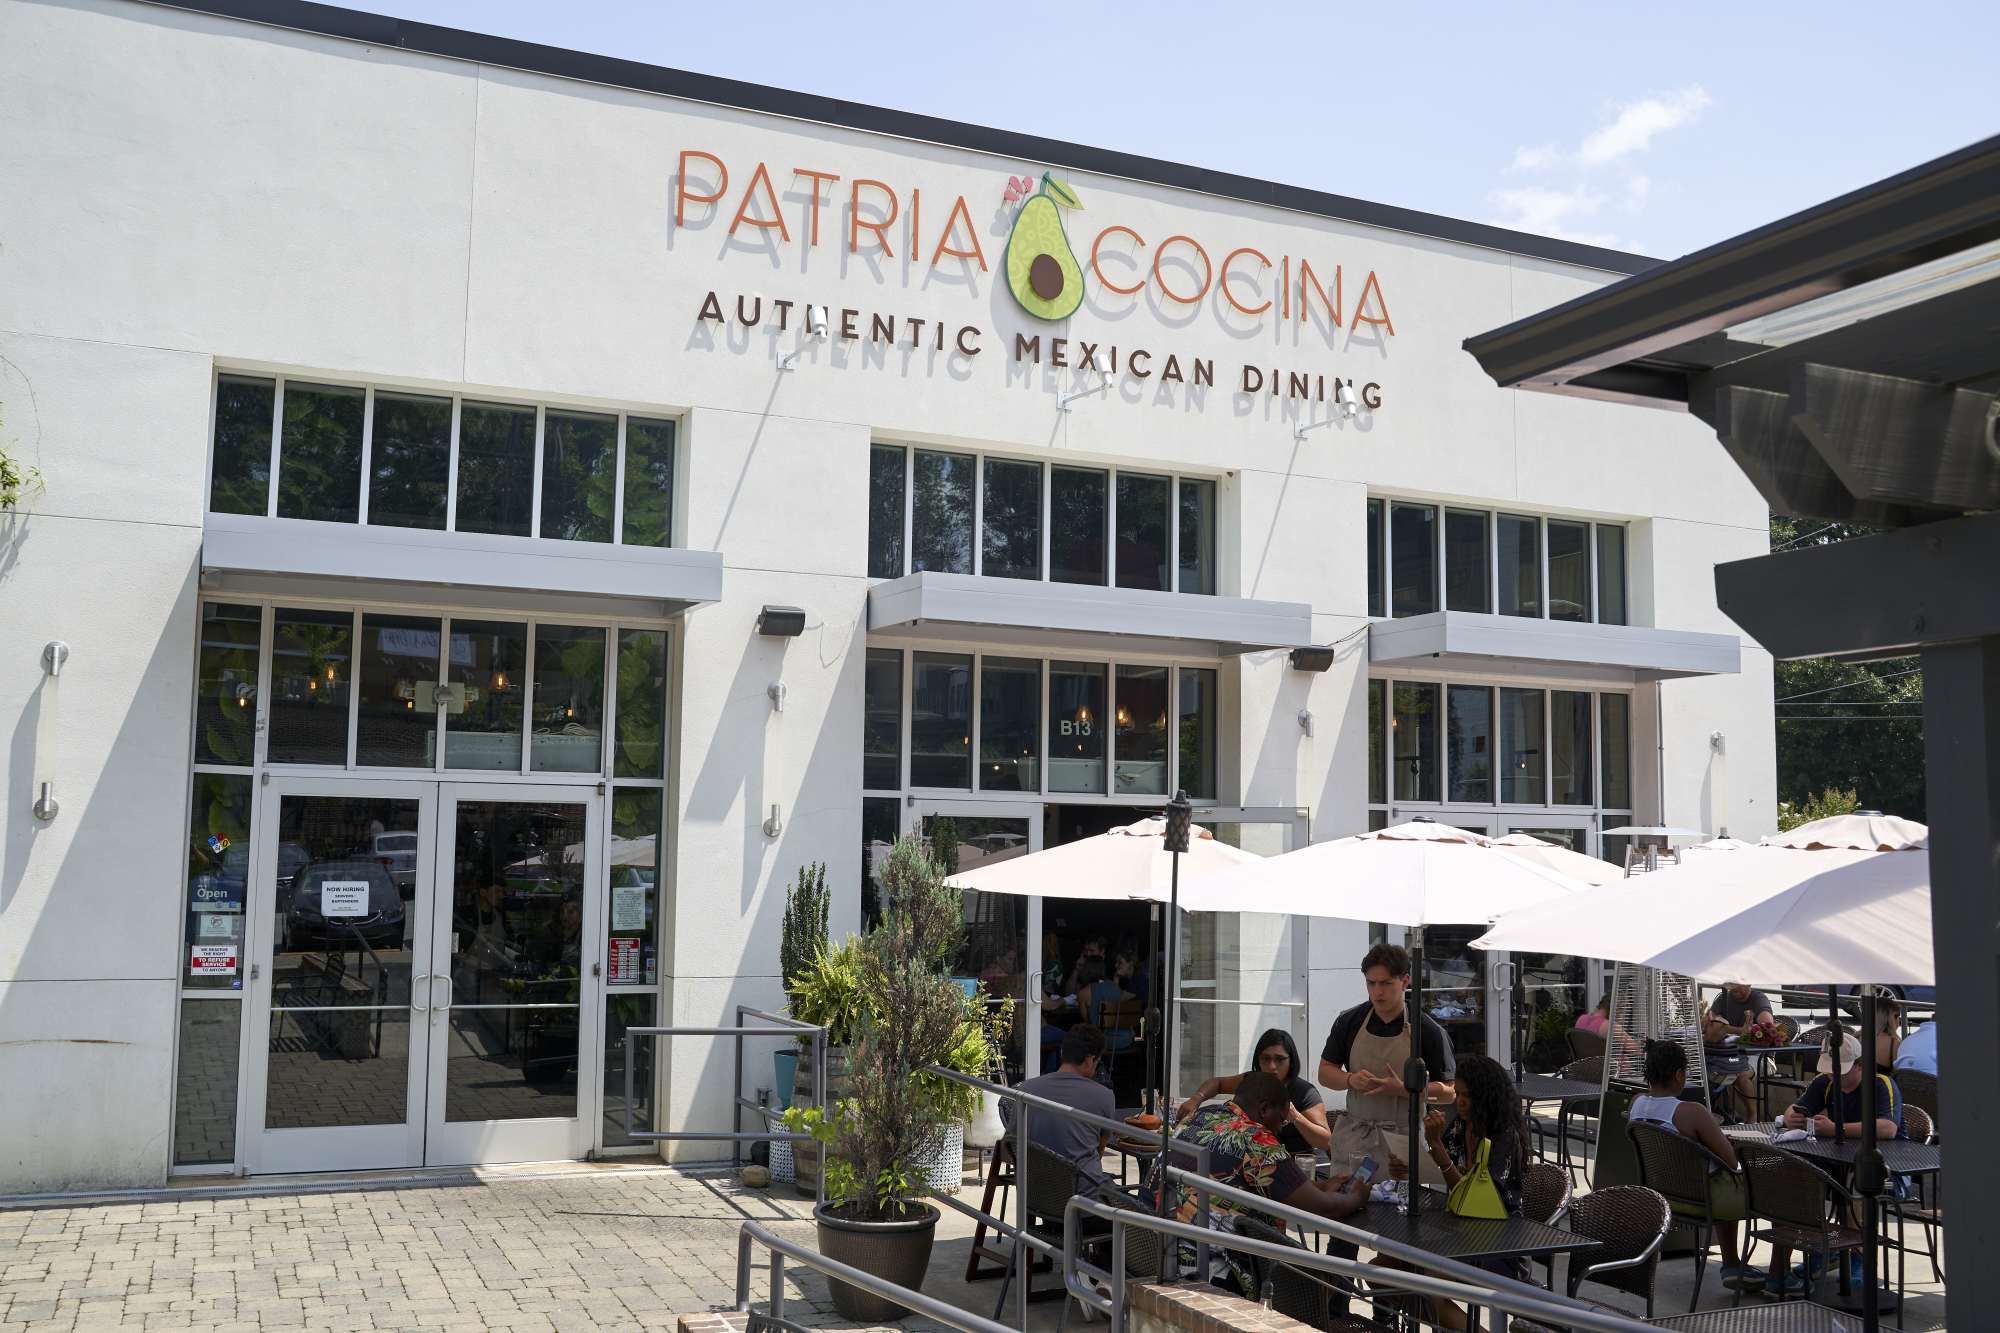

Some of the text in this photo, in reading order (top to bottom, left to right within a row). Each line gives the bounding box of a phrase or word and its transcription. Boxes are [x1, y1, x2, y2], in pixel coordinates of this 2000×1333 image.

[677, 151, 1395, 336] PATRIA COCINA
[1015, 333, 1214, 387] MEXICAN
[1243, 364, 1383, 409] DINING
[1060, 720, 1091, 736] B13
[197, 888, 228, 899] Open
